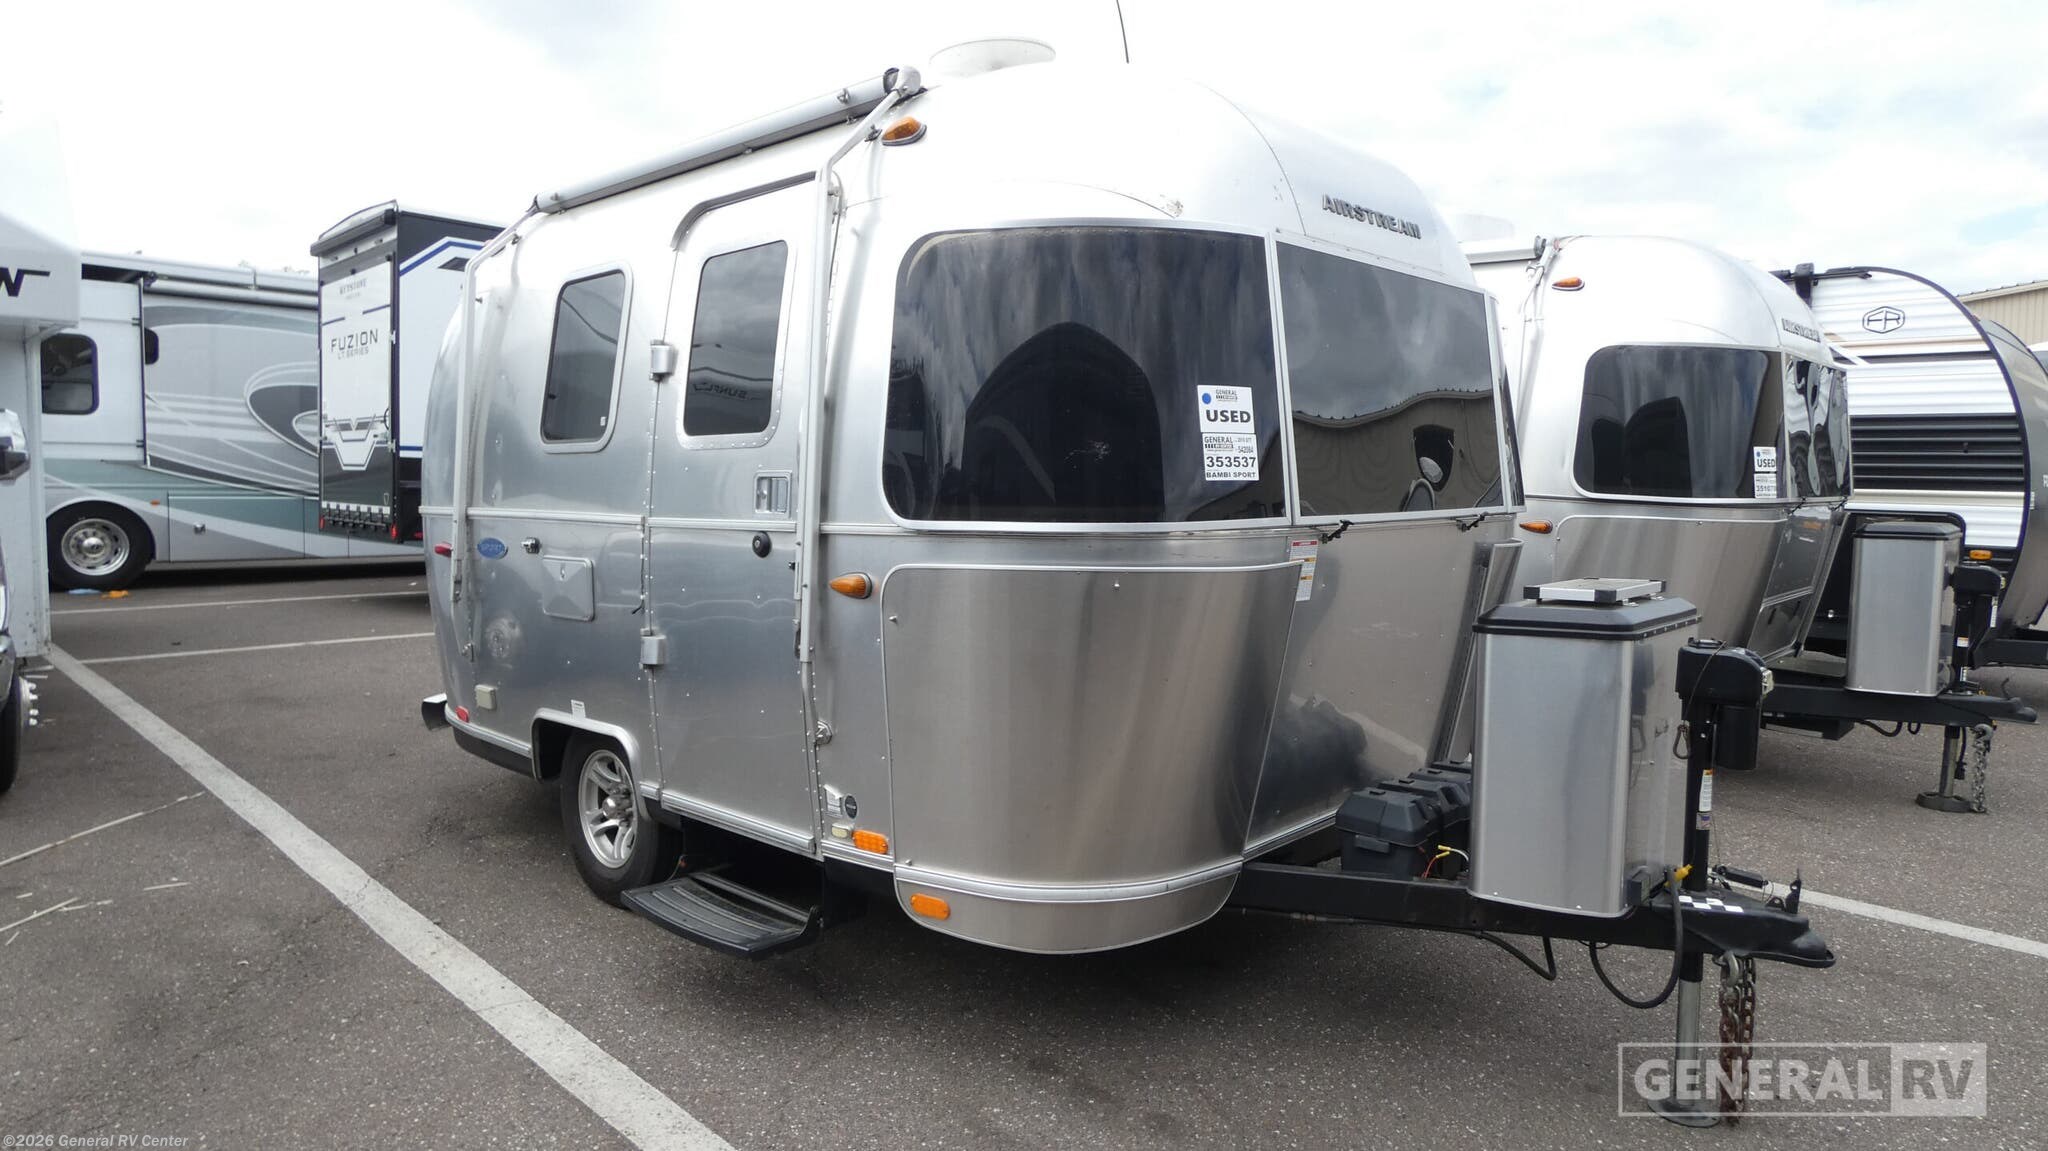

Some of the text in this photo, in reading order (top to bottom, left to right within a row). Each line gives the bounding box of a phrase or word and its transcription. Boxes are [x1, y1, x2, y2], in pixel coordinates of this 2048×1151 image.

[1322, 193, 1421, 240] AIRSTREAM
[330, 328, 379, 352] FUZION
[1206, 409, 1251, 423] USED
[1204, 436, 1233, 444] GENERAL
[1206, 456, 1256, 468] 353537
[1756, 458, 1776, 468] USED
